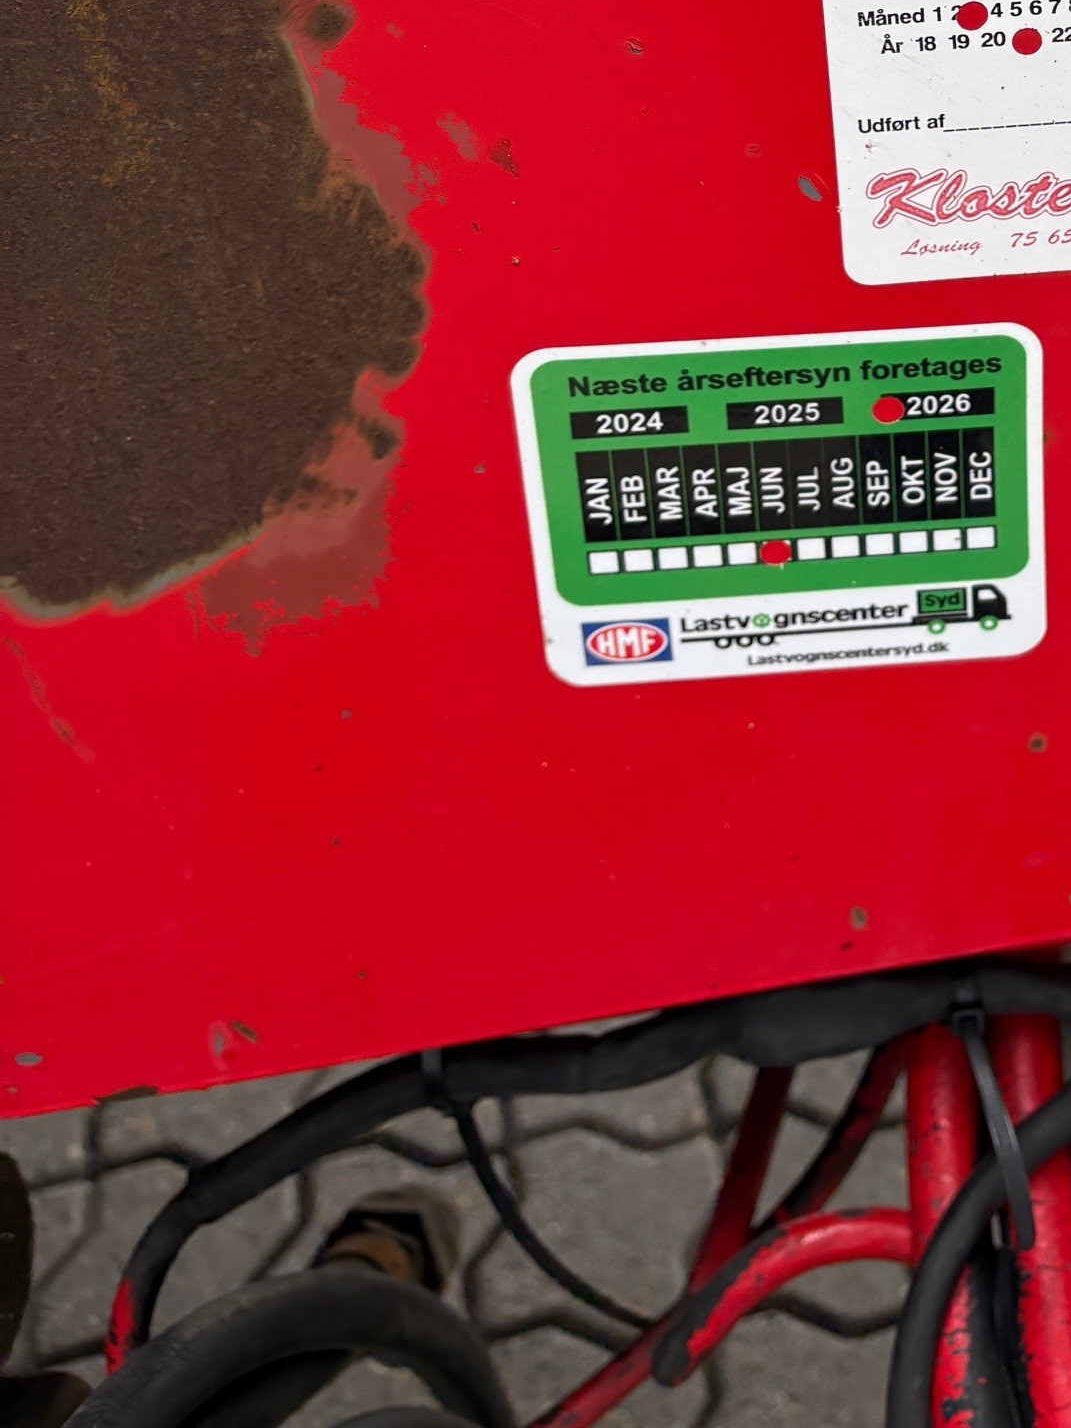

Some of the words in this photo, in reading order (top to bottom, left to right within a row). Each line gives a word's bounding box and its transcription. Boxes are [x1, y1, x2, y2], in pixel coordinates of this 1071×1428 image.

[857, 8, 925, 27] Måned
[933, 6, 942, 22] 1
[990, 2, 1003, 18] 4
[1010, 1, 1023, 17] 5
[1029, 0, 1042, 16] 6
[881, 34, 904, 54] År
[916, 35, 936, 51] 18
[948, 34, 970, 49] 19
[981, 31, 1006, 47] 20
[858, 115, 920, 134] Udført
[927, 113, 945, 130] af
[900, 238, 983, 256] Løsning
[1010, 232, 1037, 248] 75
[568, 371, 668, 397] Næste
[677, 362, 852, 394] årseftersyn
[860, 354, 1002, 384] foretages
[596, 411, 664, 435] 2024
[754, 402, 821, 426] 2025
[907, 393, 972, 417] 2026
[658, 465, 683, 521] MAR
[691, 466, 719, 518] APR
[726, 465, 752, 517] MAJ
[761, 465, 785, 514] JUN
[796, 465, 821, 511] JUL
[830, 456, 855, 509] AUG
[866, 459, 890, 507] SEP
[901, 455, 925, 505] OKT
[932, 451, 959, 503] NOV
[968, 449, 993, 501] DEC
[585, 476, 613, 526] JAN
[622, 474, 647, 524] FEB
[924, 591, 961, 608] Syd
[596, 627, 658, 659] HMF
[748, 640, 949, 666] Lastvognscentersyd.dk
